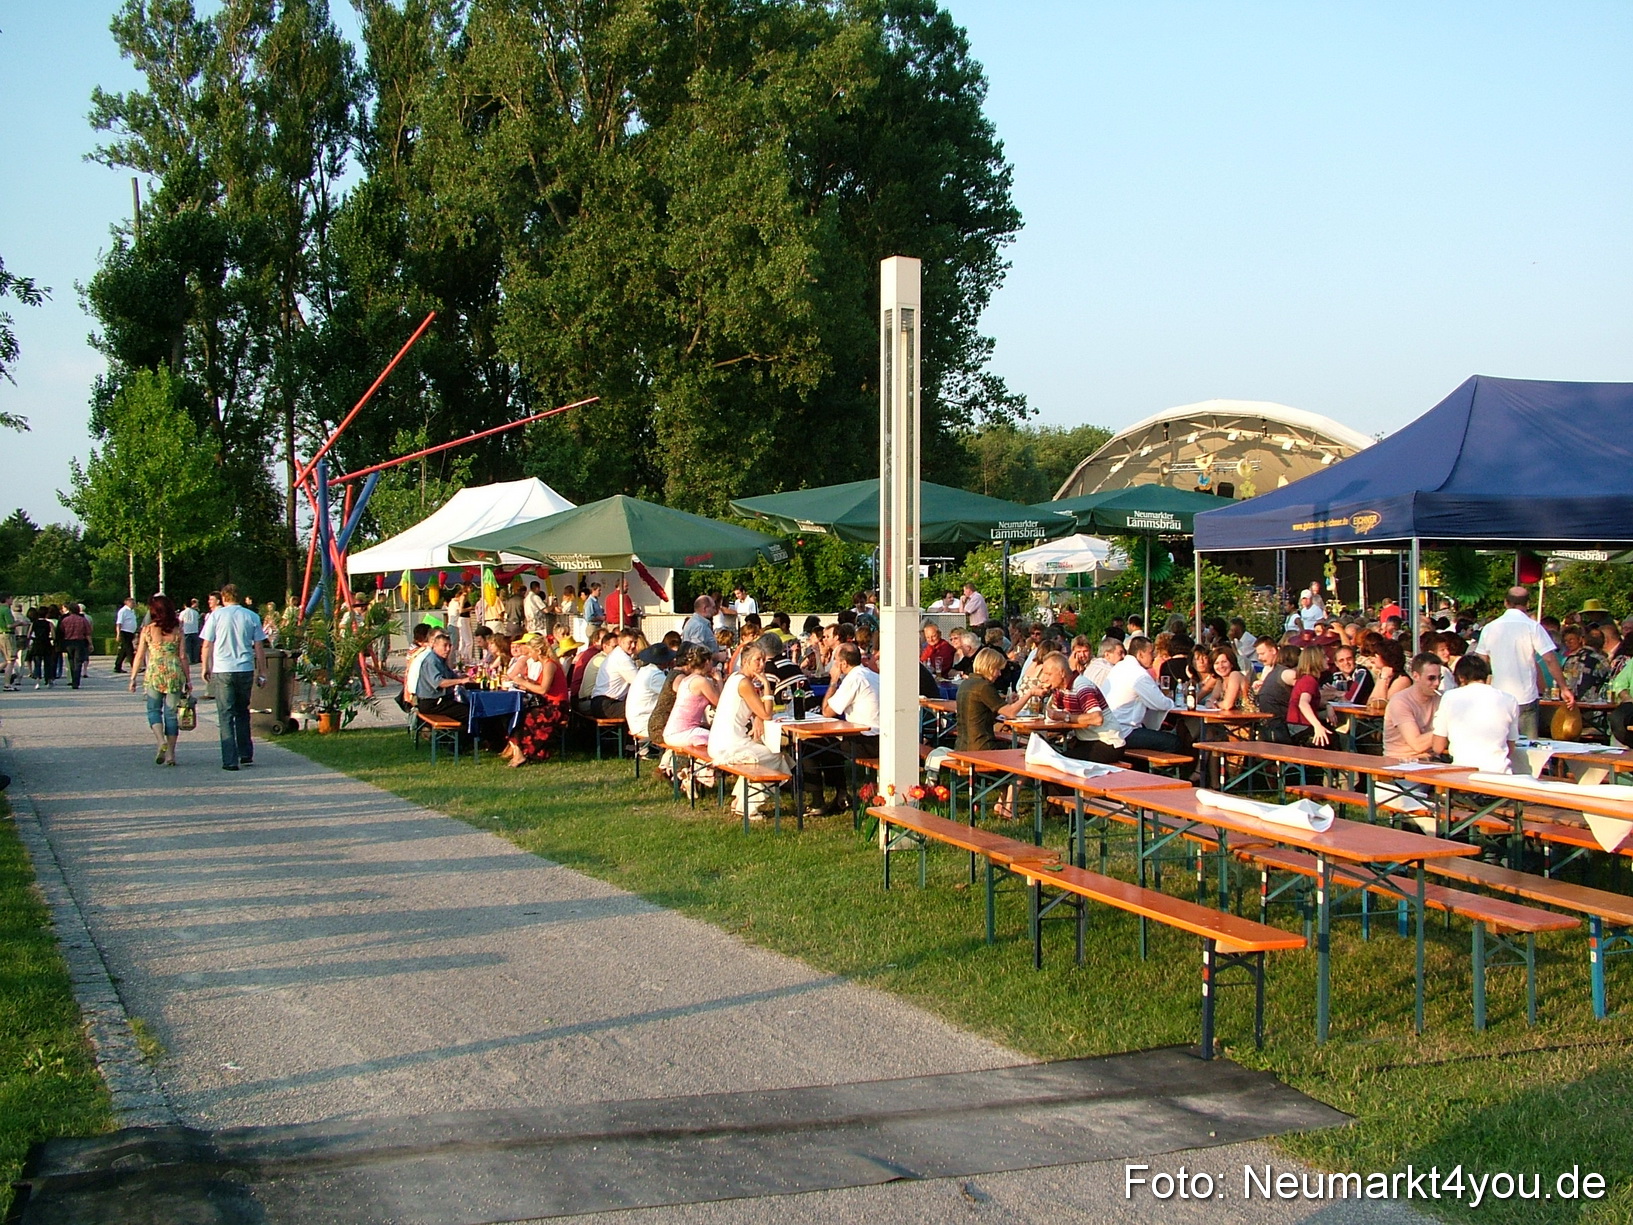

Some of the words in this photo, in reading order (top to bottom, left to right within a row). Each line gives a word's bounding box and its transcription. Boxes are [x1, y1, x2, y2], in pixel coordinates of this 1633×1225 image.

[1134, 510, 1174, 519] Neumarkter
[998, 520, 1039, 529] Neumarkter
[1126, 516, 1181, 530] Lammsbräu
[991, 527, 1046, 539] Lammsbräu
